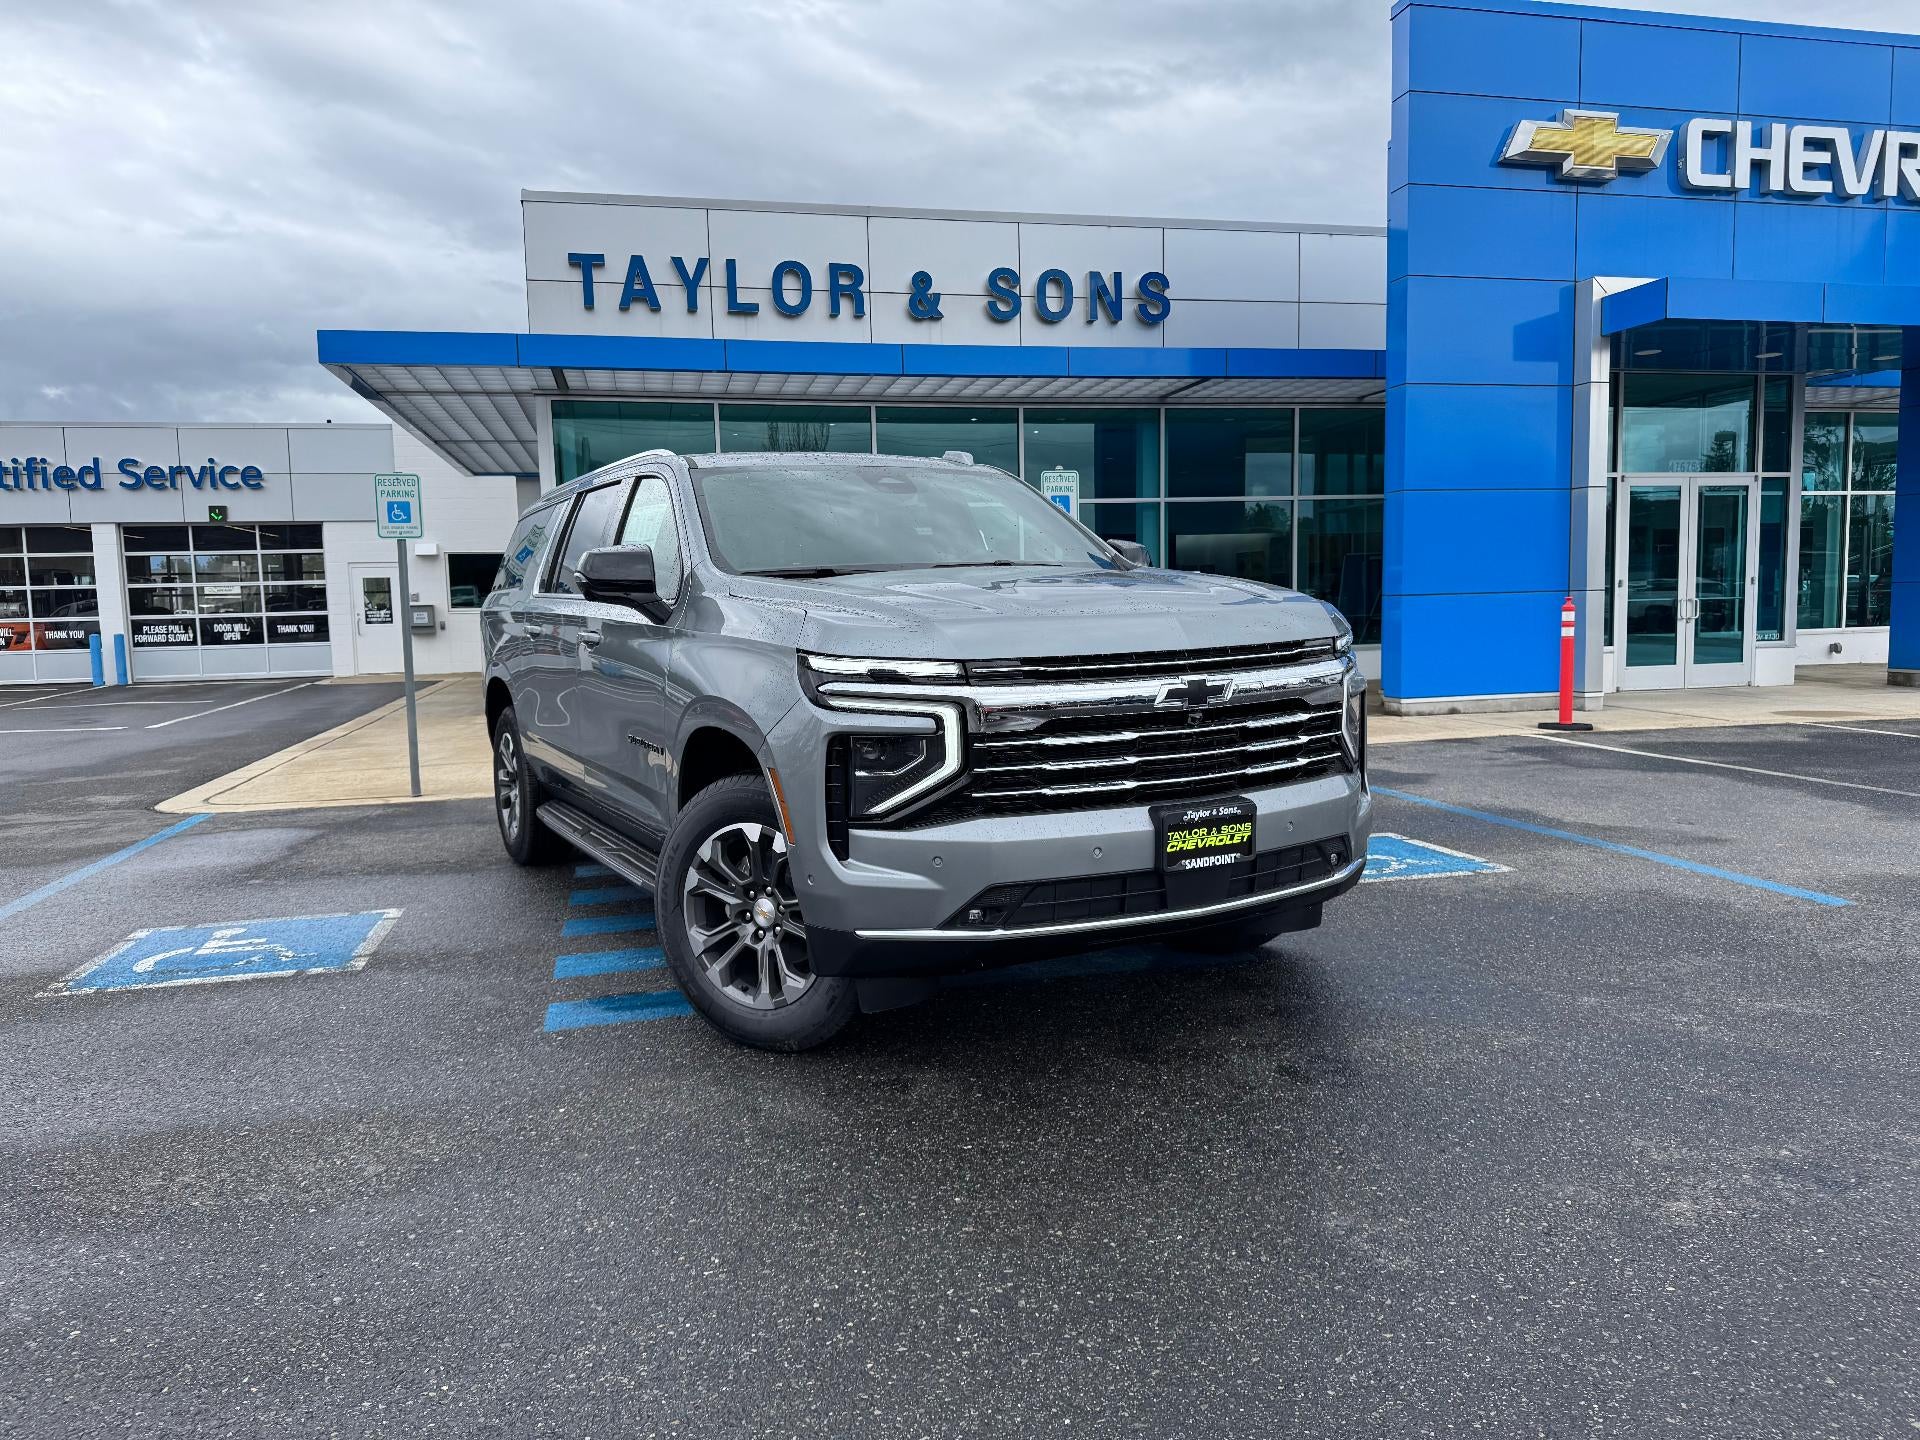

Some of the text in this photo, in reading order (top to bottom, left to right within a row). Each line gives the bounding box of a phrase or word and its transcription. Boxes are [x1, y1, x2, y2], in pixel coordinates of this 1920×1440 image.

[568, 252, 1171, 326] TAYLOR & SONS
[118, 457, 264, 490] Service
[377, 478, 416, 487] RESERVED
[380, 489, 415, 498] PARKING
[1046, 485, 1074, 493] PARKING
[142, 624, 186, 634] PLEASE PULL
[213, 623, 248, 632] DOOR WILL
[277, 624, 315, 633] THANK YOU!
[45, 630, 68, 639] THANK
[134, 634, 167, 643] FORWARD
[223, 632, 241, 640] OPEN
[1186, 806, 1238, 821] Taylor & Sons
[1167, 822, 1252, 841] TAYLOR & SONS
[1166, 832, 1252, 852] CHEVROLET
[1185, 853, 1237, 870] SANDPOINT
